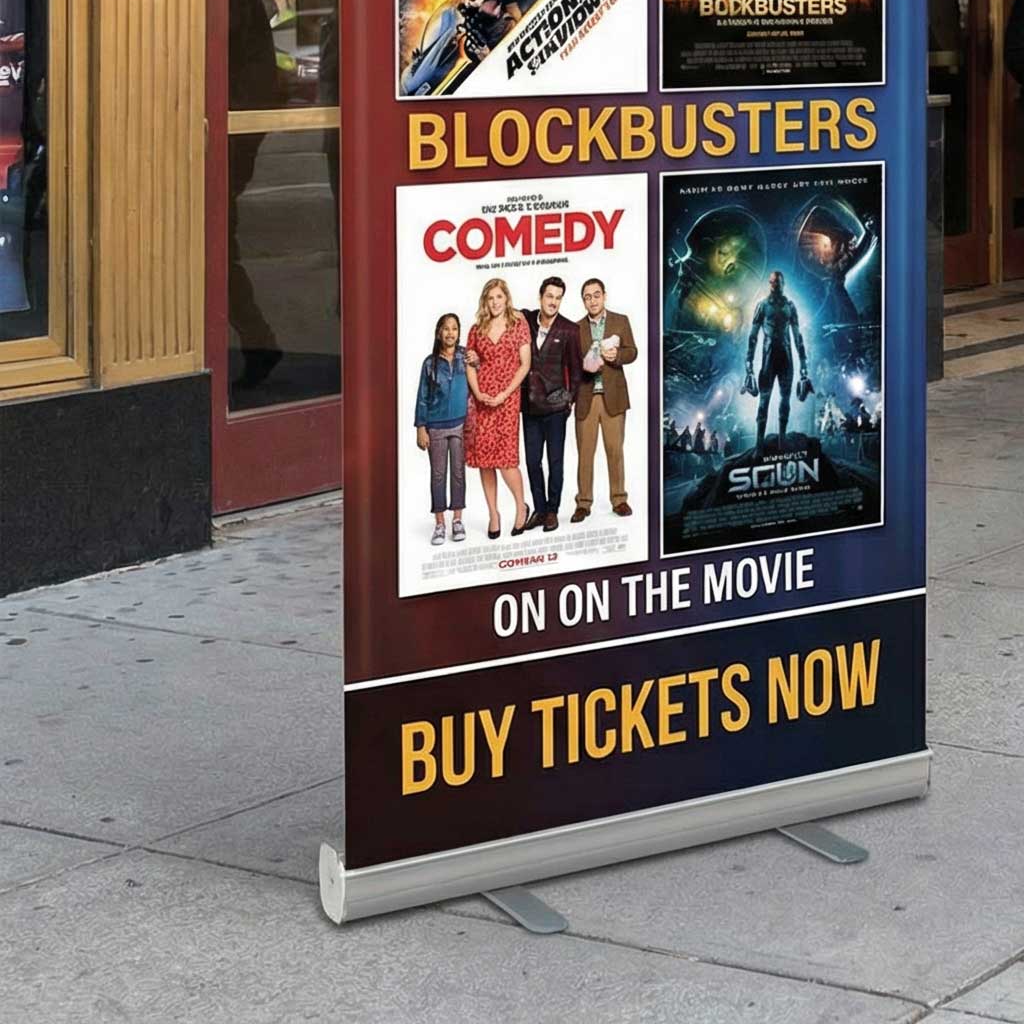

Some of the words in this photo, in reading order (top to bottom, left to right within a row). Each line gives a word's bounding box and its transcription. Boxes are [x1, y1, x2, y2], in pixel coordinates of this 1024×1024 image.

[408, 97, 877, 170] BLOCKBUSTERS
[423, 209, 625, 263] COMEDY
[493, 589, 546, 638] ON
[558, 580, 610, 628] ON
[621, 565, 692, 617] THE
[703, 548, 815, 604] MOVIE
[401, 703, 516, 796] BUY
[531, 663, 751, 769] TICKETS
[768, 639, 881, 724] NOW
